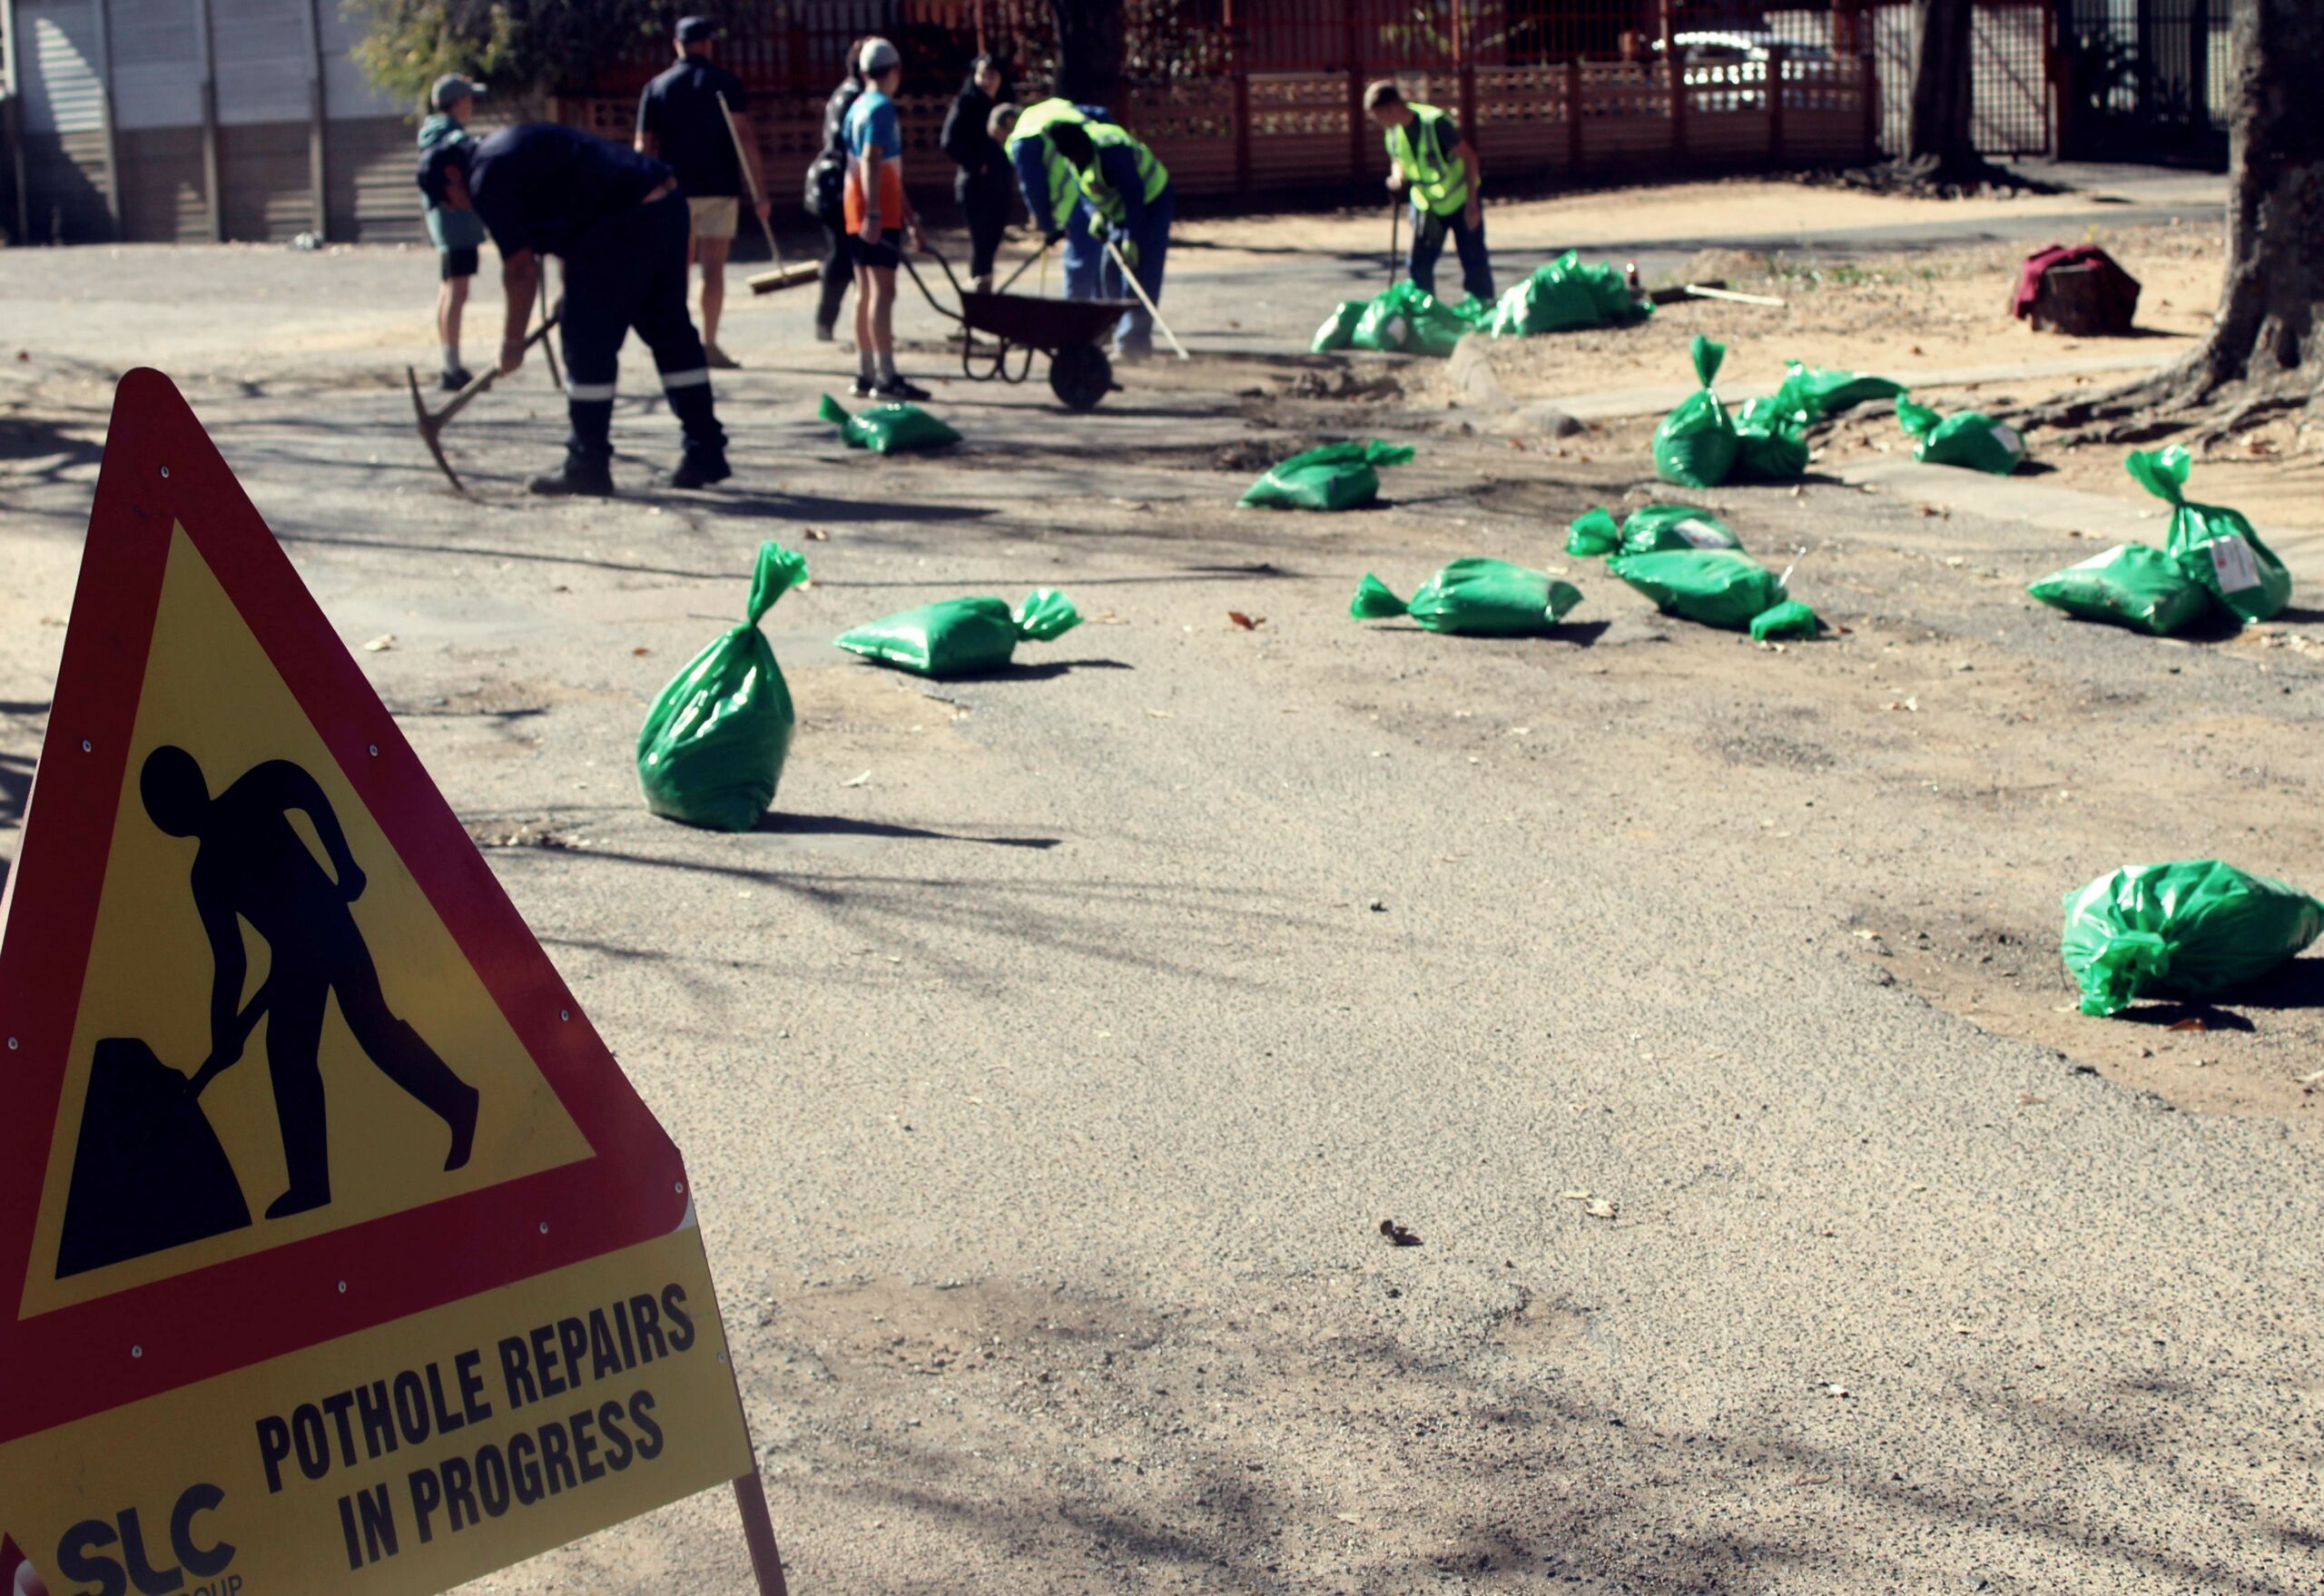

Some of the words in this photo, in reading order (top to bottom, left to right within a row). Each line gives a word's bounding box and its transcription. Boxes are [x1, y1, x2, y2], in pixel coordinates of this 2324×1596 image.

[254, 1348, 493, 1494] POTHOLE
[497, 1283, 695, 1410] REPAIRS
[56, 1483, 236, 1596] SLC
[337, 1483, 399, 1571] IN
[408, 1389, 665, 1543] PROGRESS
